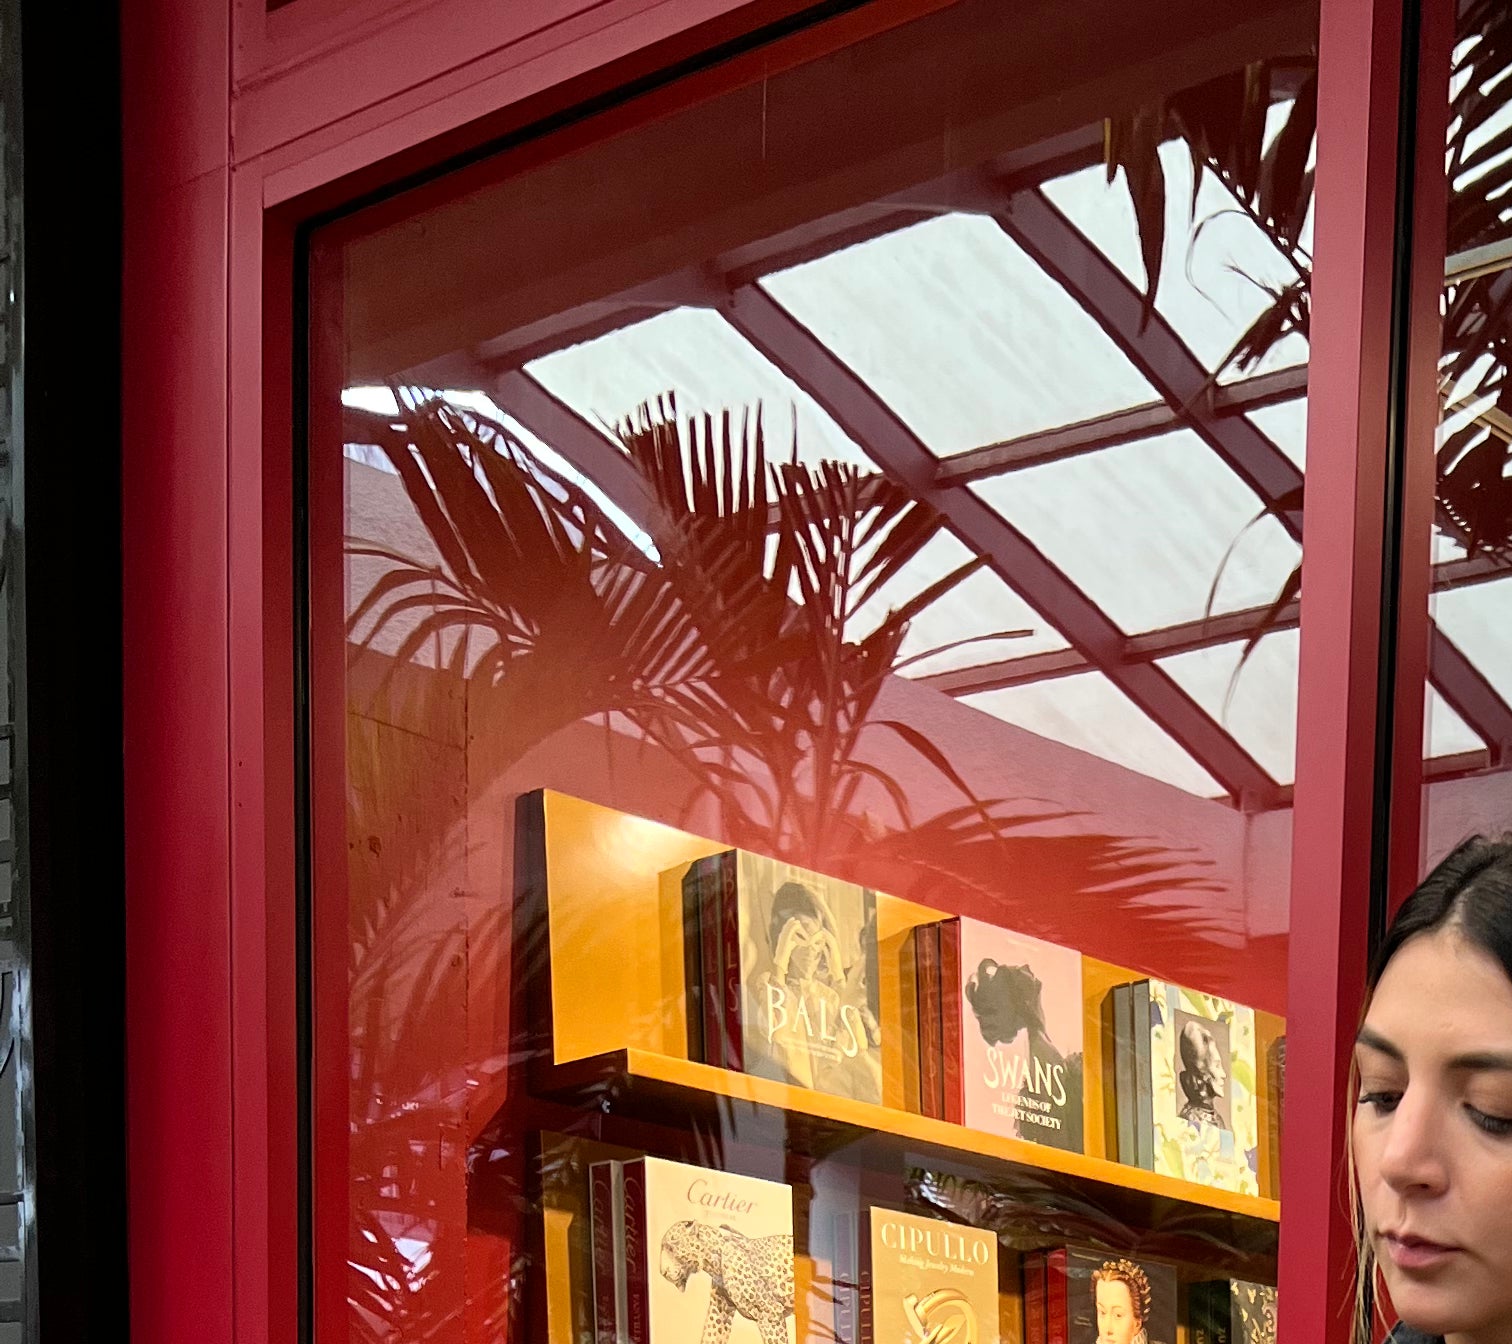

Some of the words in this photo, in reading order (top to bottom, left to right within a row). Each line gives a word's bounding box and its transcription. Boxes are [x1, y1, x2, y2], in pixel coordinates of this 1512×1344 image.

[766, 981, 859, 1058] BALS
[983, 1046, 1067, 1107] SWANS
[1008, 1107, 1026, 1121] JET
[1025, 1112, 1063, 1130] SOCIETY
[1039, 1101, 1053, 1113] OF
[687, 1178, 759, 1215] Cartier
[623, 1176, 642, 1275] Cartier
[881, 1222, 990, 1265] CIPULLO
